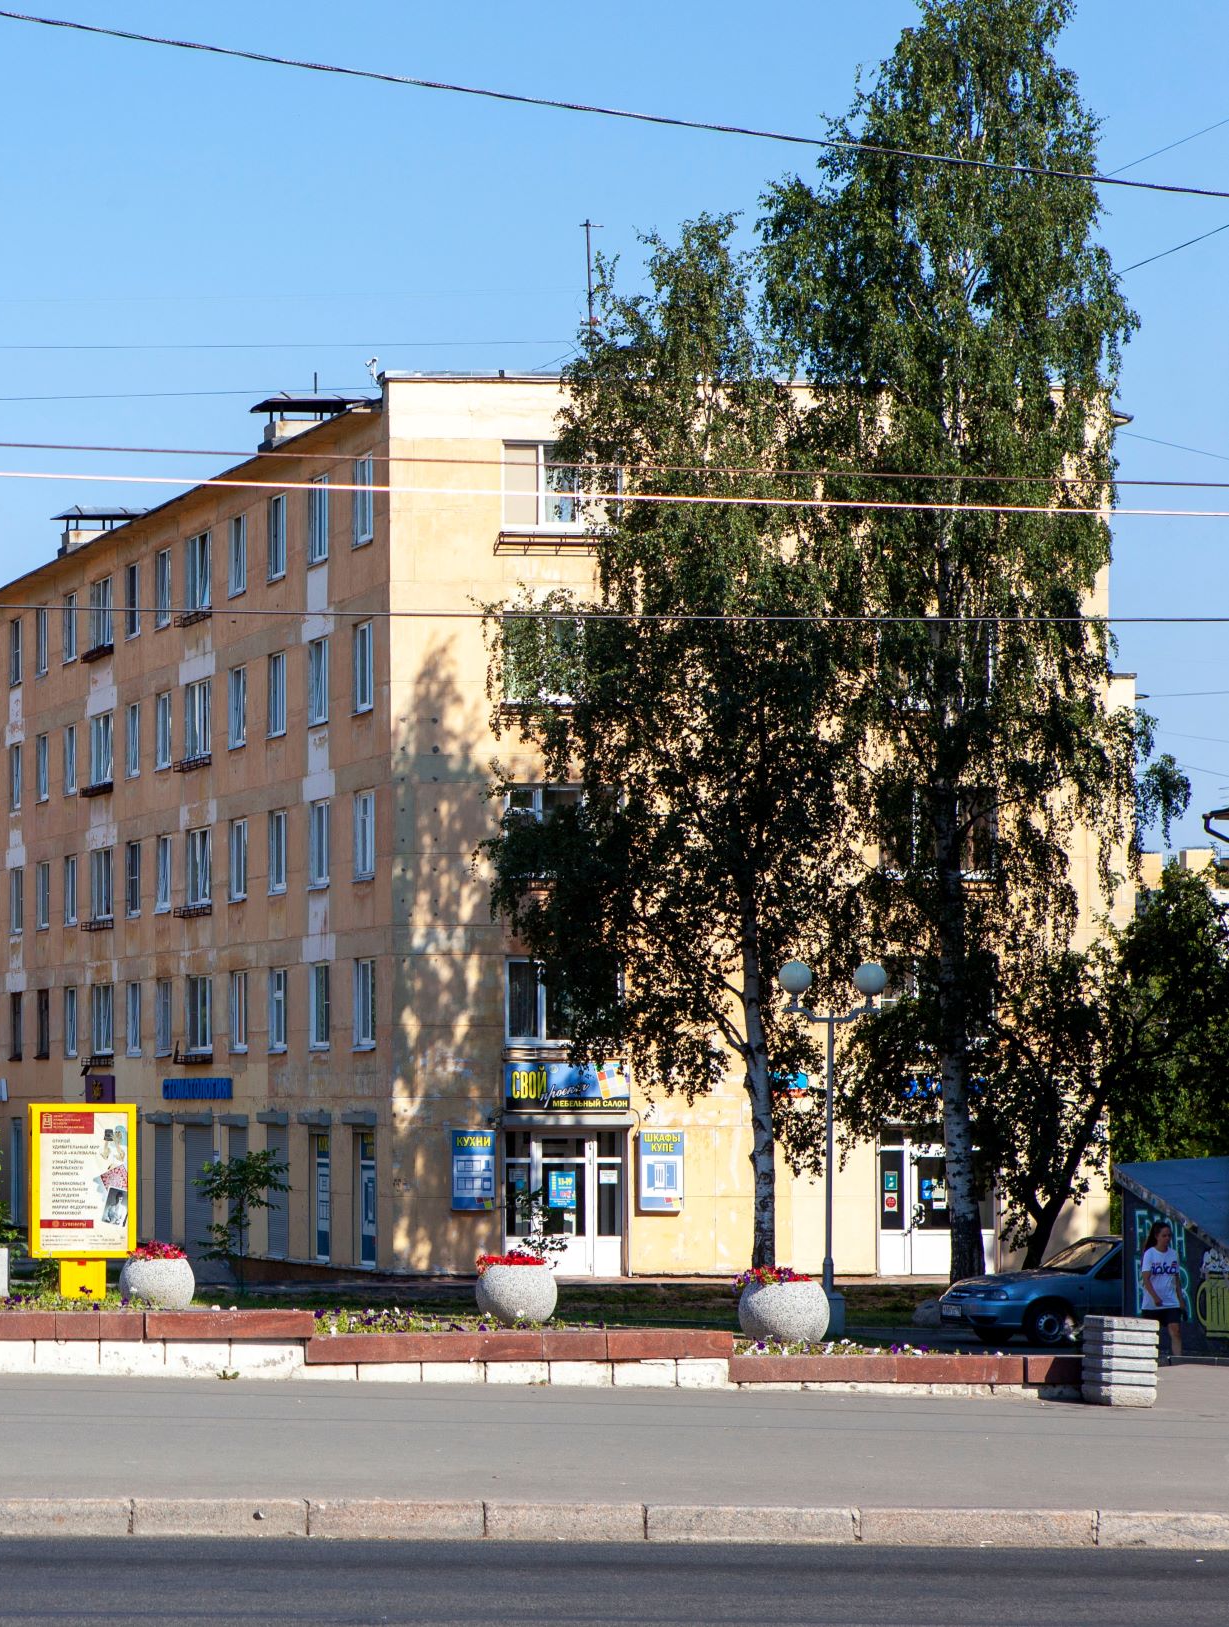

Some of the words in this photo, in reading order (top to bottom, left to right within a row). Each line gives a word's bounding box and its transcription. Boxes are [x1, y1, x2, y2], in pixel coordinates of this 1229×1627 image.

[512, 1065, 547, 1099] СВОЙ
[164, 1078, 228, 1099] СТОМАТОЛОГИЯ
[553, 1099, 601, 1108] МЕБЕЛЬНЫЙ
[456, 1136, 491, 1147] КУХНИ
[644, 1133, 680, 1142] ШКАФЫ
[651, 1143, 674, 1152] КУПЕ
